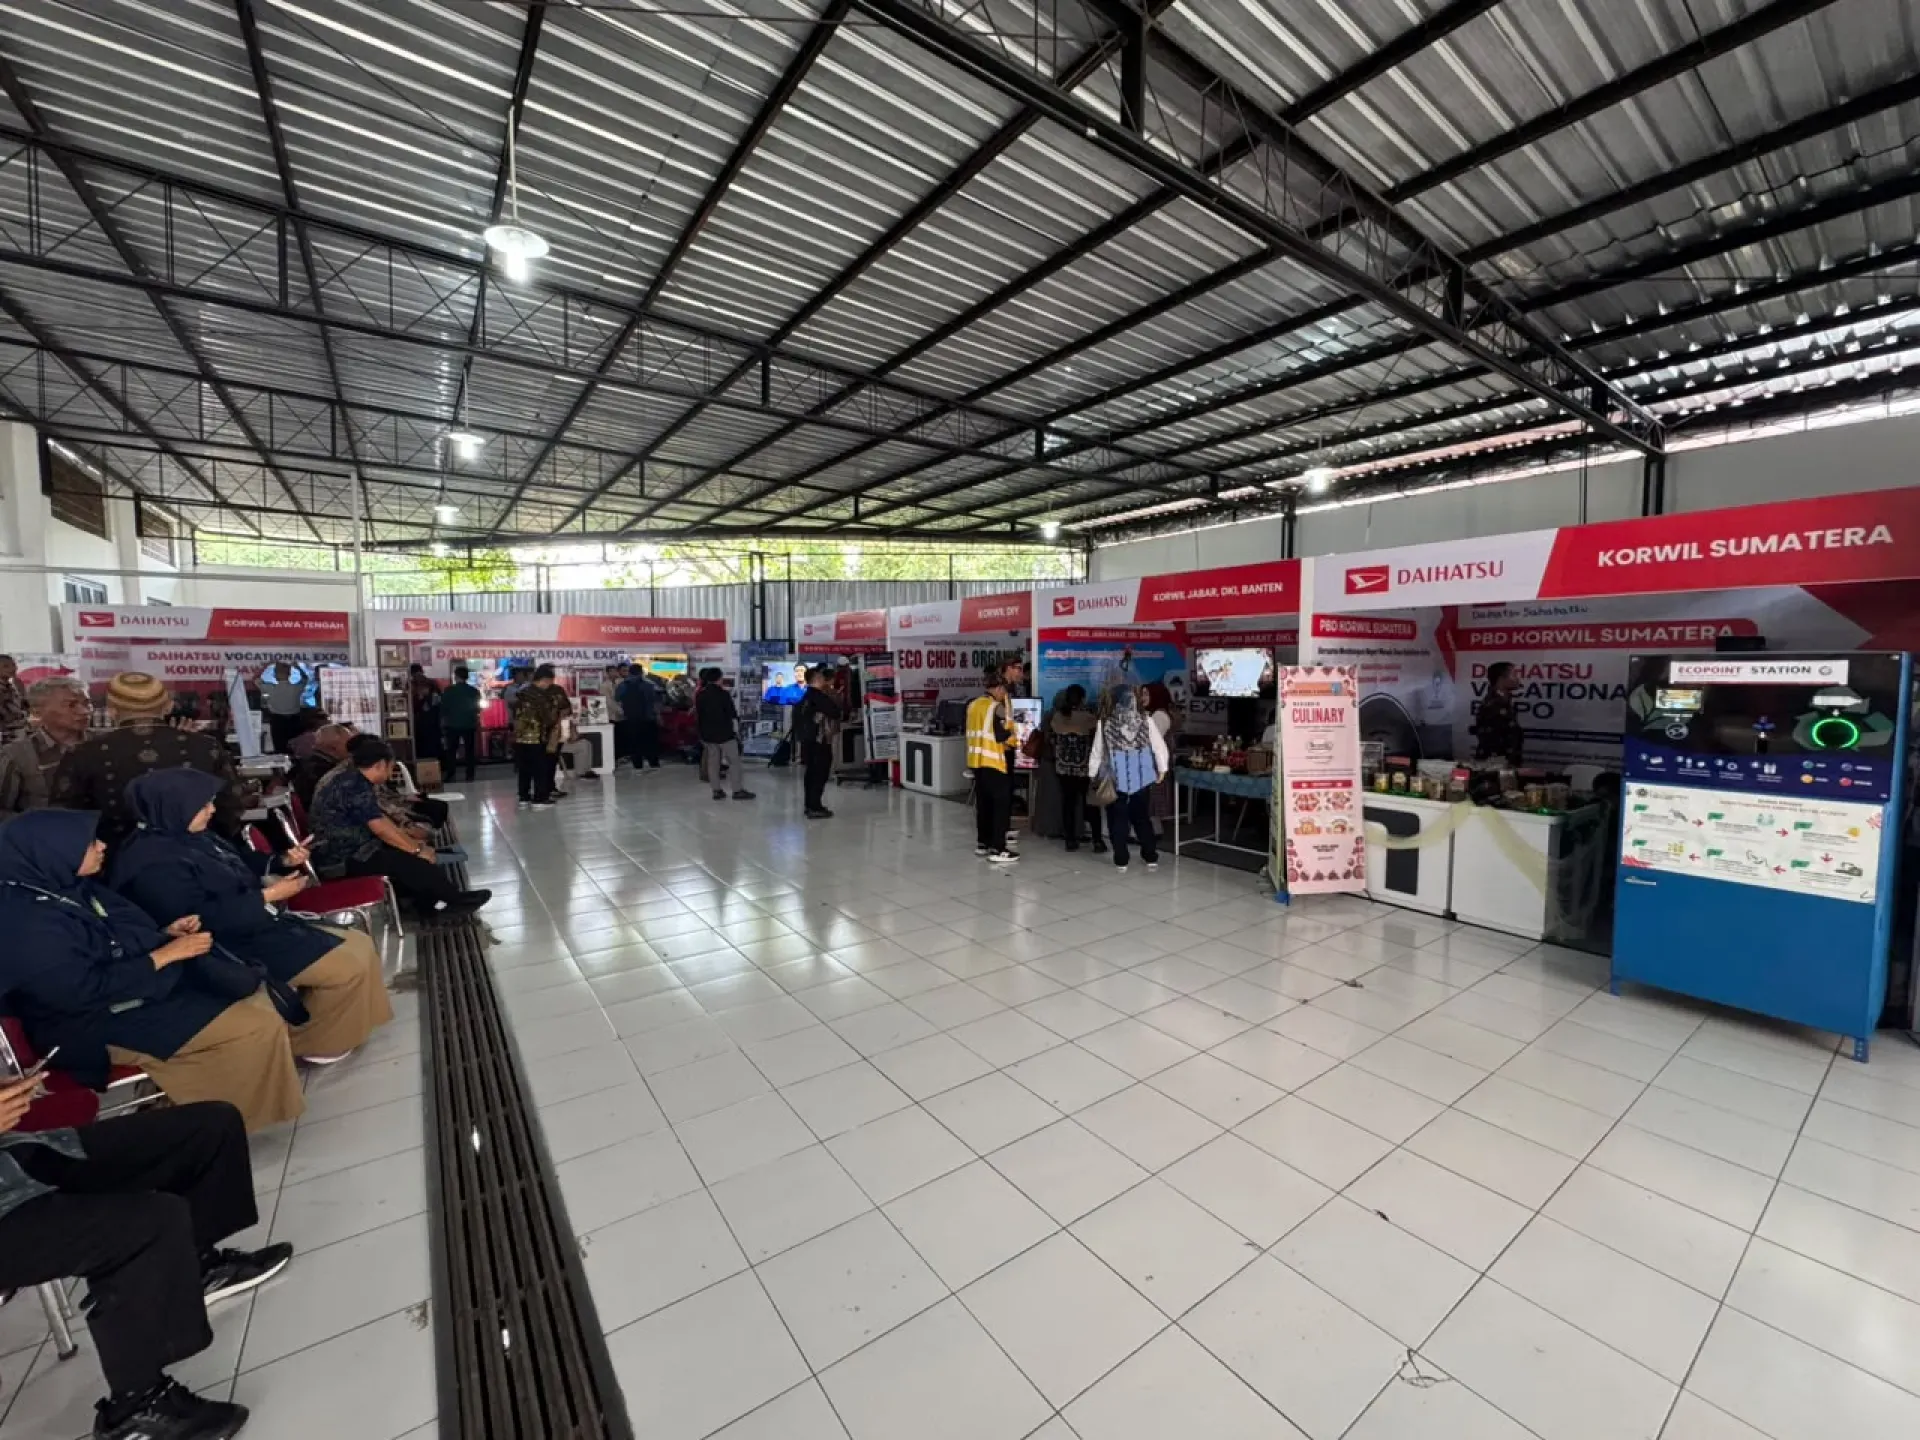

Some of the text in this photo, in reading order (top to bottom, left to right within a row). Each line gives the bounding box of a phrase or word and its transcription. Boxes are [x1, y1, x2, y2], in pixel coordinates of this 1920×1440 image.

[1597, 524, 1894, 568] KORWIL SUMATERA
[1397, 560, 1504, 586] DAIHATSU
[1242, 582, 1284, 595] BANTEN
[1078, 595, 1128, 611] DAIHATSU
[120, 615, 190, 627] DAIHATSU
[224, 619, 345, 630] KORWIL JAWA TENGAH
[434, 620, 487, 631] DAIHATSU
[600, 624, 637, 634] KORWIL
[638, 625, 666, 635] JAWA
[1470, 623, 1735, 646] PBD KORWIL SUMATERA
[147, 650, 349, 661] DAIHATSU VOCATIONAL EXPO
[436, 648, 506, 659] DAIHATSU
[509, 648, 590, 660] VOCATIONAL
[899, 649, 923, 670] ECO
[926, 650, 957, 670] CHIC
[959, 651, 969, 670] &
[1472, 663, 1594, 680] DHATSU
[1677, 665, 1813, 675] ECOPOINT STATION
[1292, 707, 1345, 724] CULINARY
[1470, 700, 1555, 720] EPO
